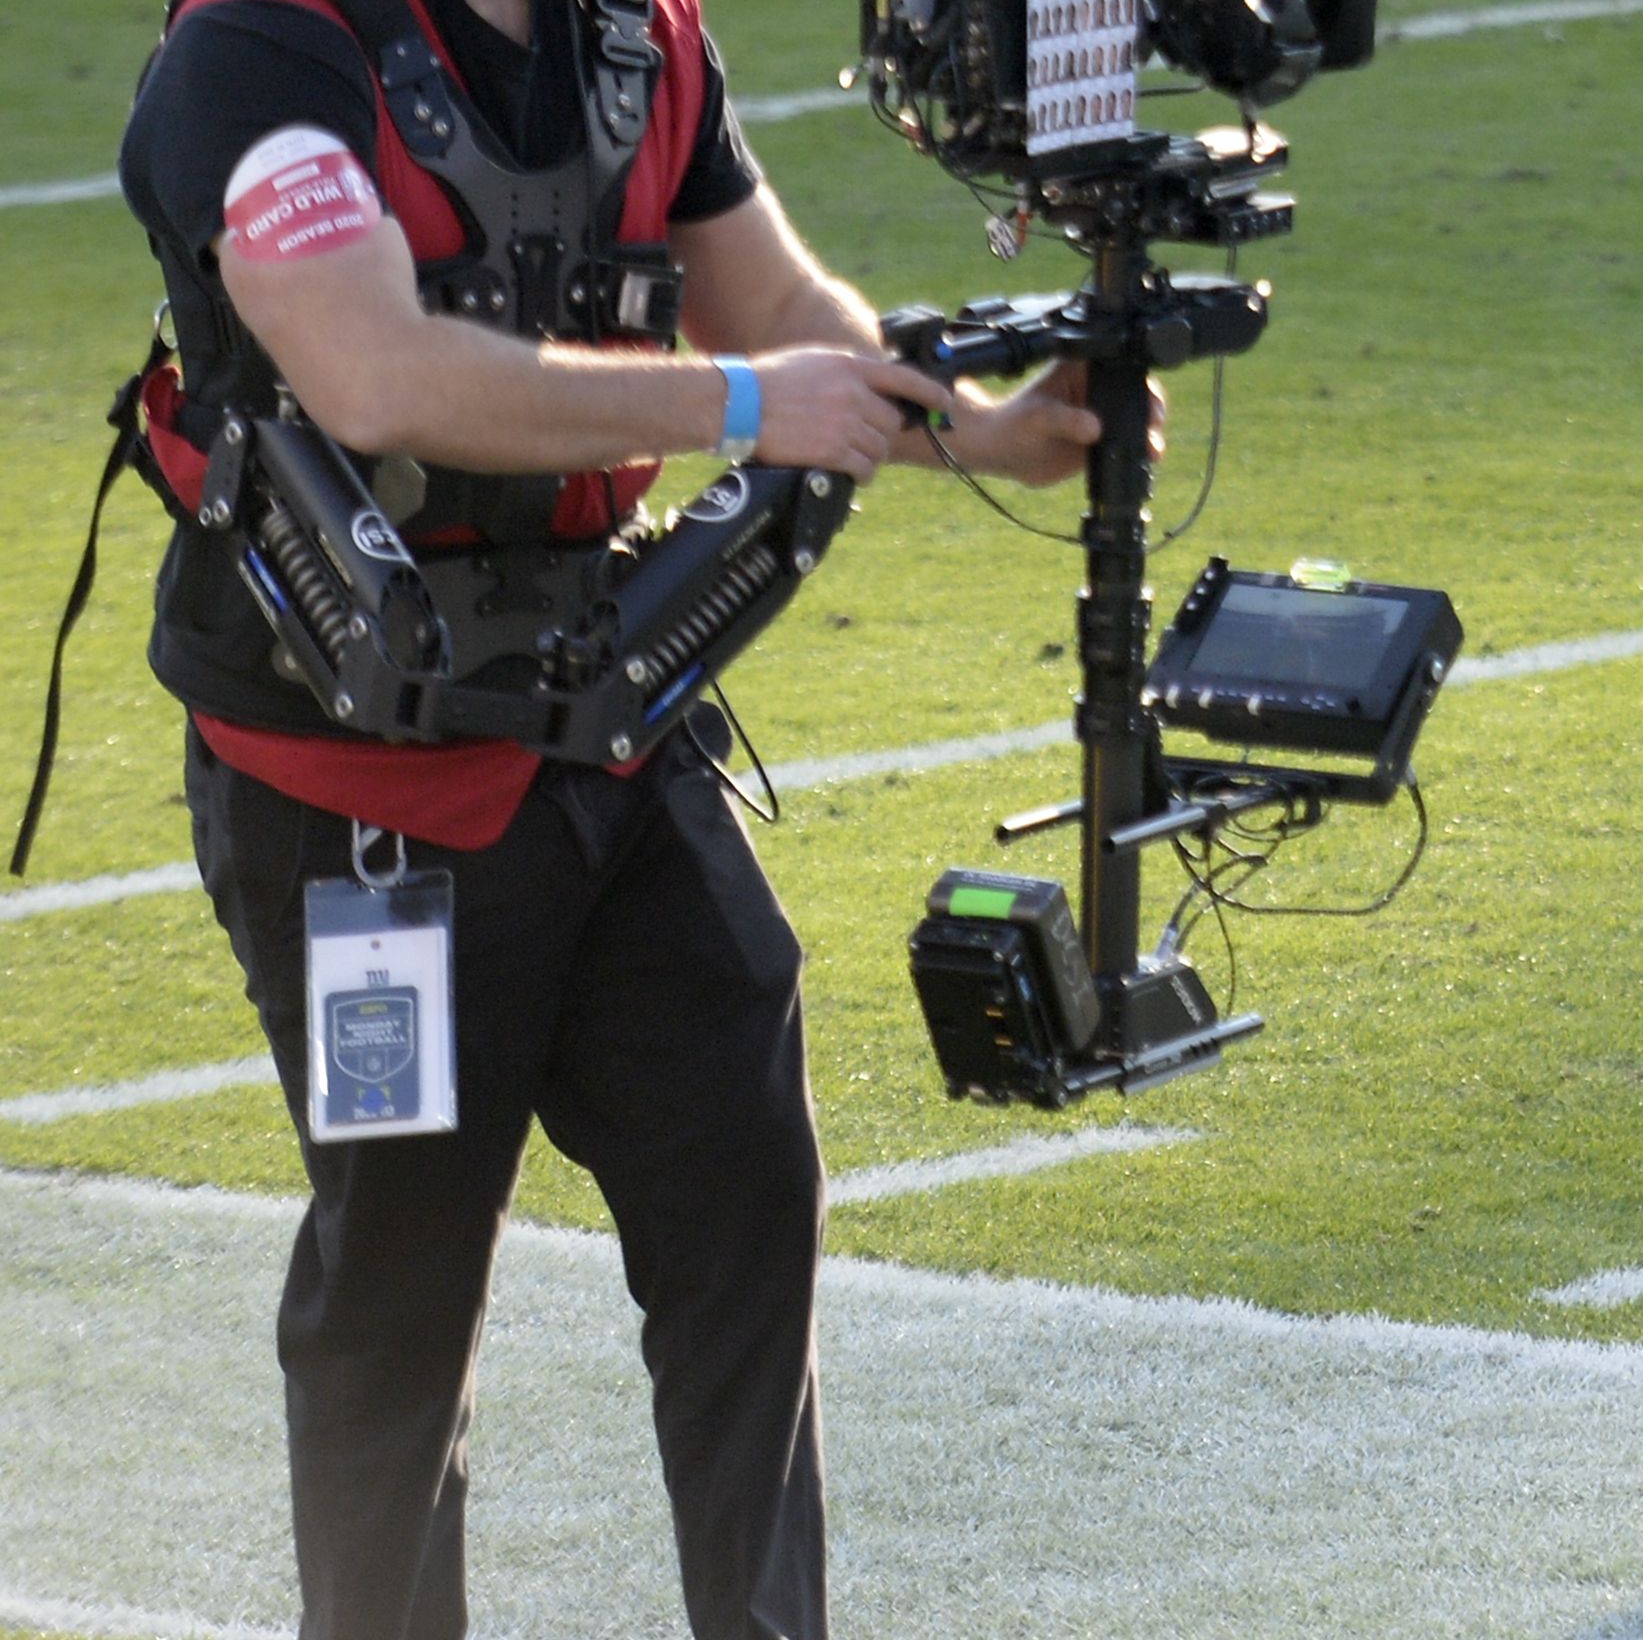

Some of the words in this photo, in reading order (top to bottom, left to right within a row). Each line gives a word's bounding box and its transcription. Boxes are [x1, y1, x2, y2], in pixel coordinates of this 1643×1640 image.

[294, 187, 342, 211] WILD
[246, 199, 294, 240] CARD
[276, 218, 337, 254] SEASON
[344, 1020, 402, 1032] MONDAY
[339, 1037, 406, 1049] FOOTBALL
